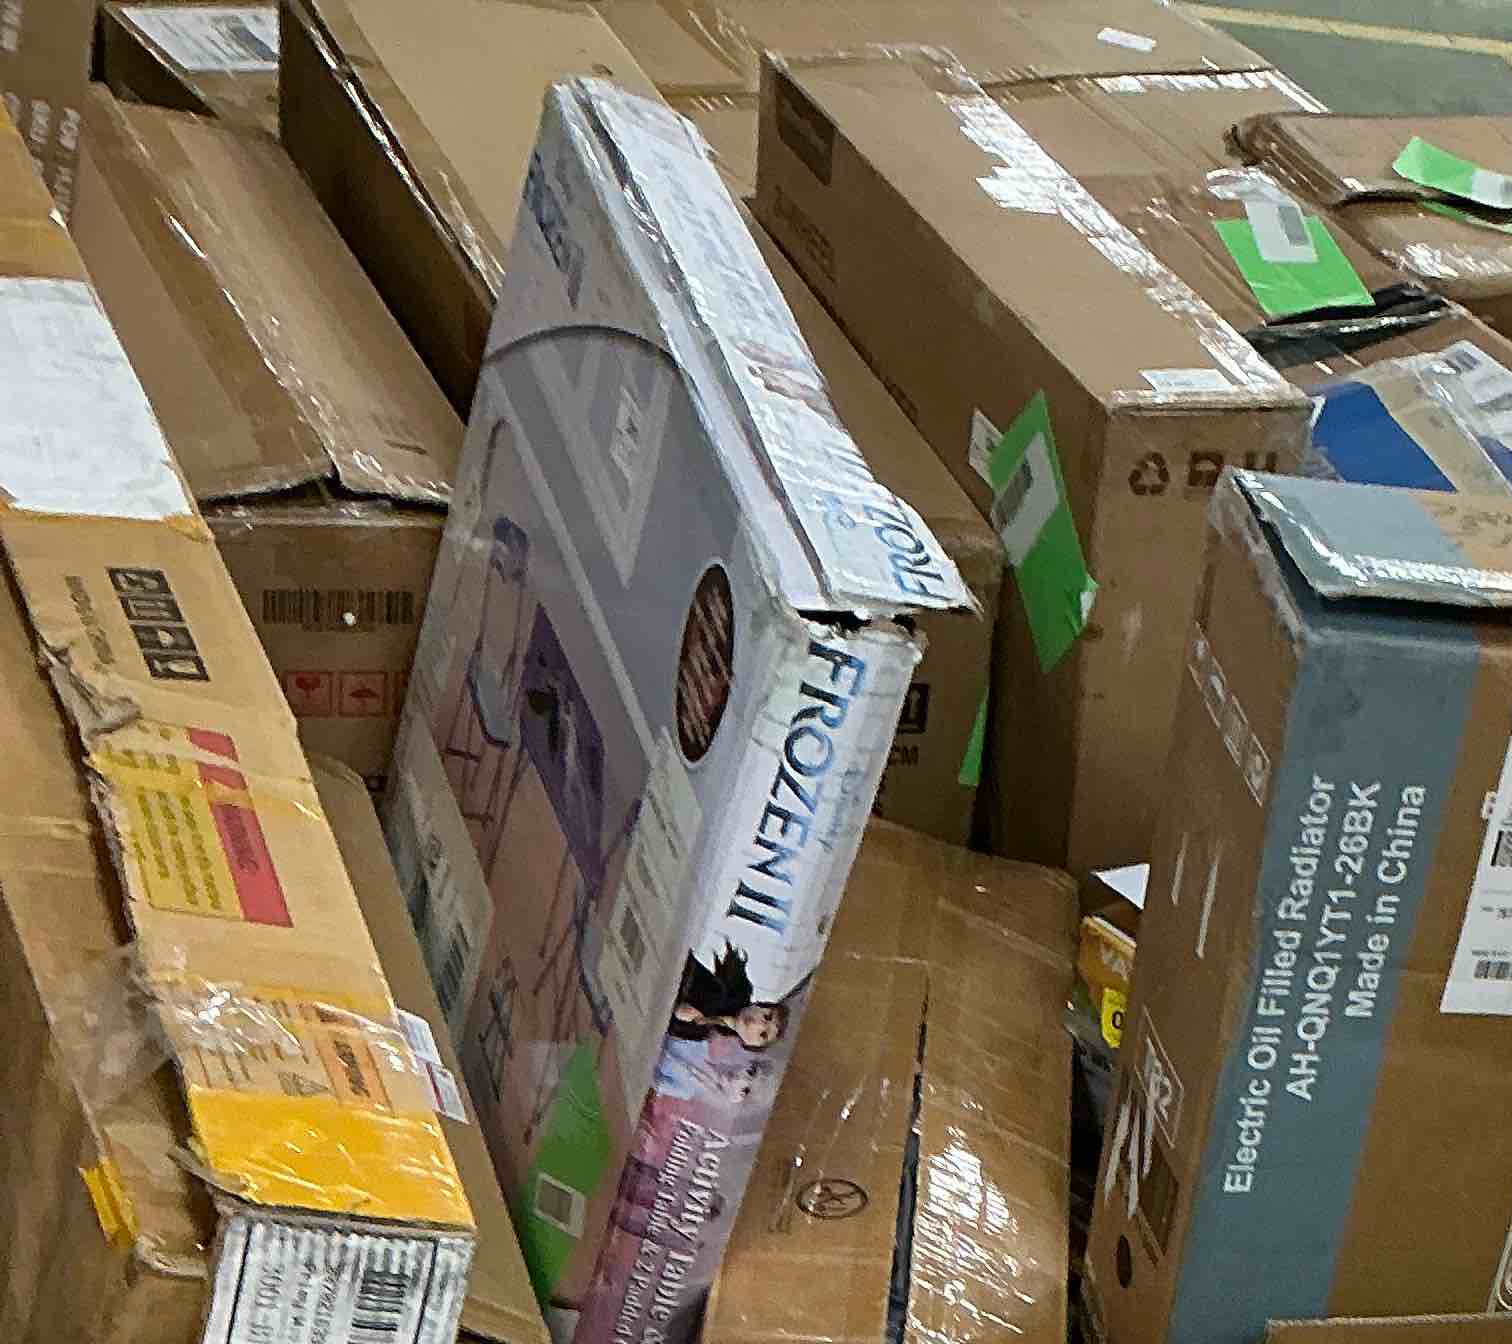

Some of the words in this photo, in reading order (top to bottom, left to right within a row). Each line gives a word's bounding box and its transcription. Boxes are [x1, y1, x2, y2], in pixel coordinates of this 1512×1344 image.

[745, 640, 866, 894] FROZEN
[1279, 774, 1337, 920] Radiator
[1382, 785, 1429, 882] China
[727, 878, 788, 934] II
[1285, 779, 1383, 1101] AH-QNQ1YT1-26BK
[1378, 891, 1400, 922] in
[1256, 925, 1300, 1010] Filled
[1344, 928, 1392, 1018] Made
[1247, 1016, 1282, 1073] Oil
[1222, 1080, 1272, 1195] Electric
[671, 1128, 732, 1241] Activity
[654, 1249, 696, 1321] Table
